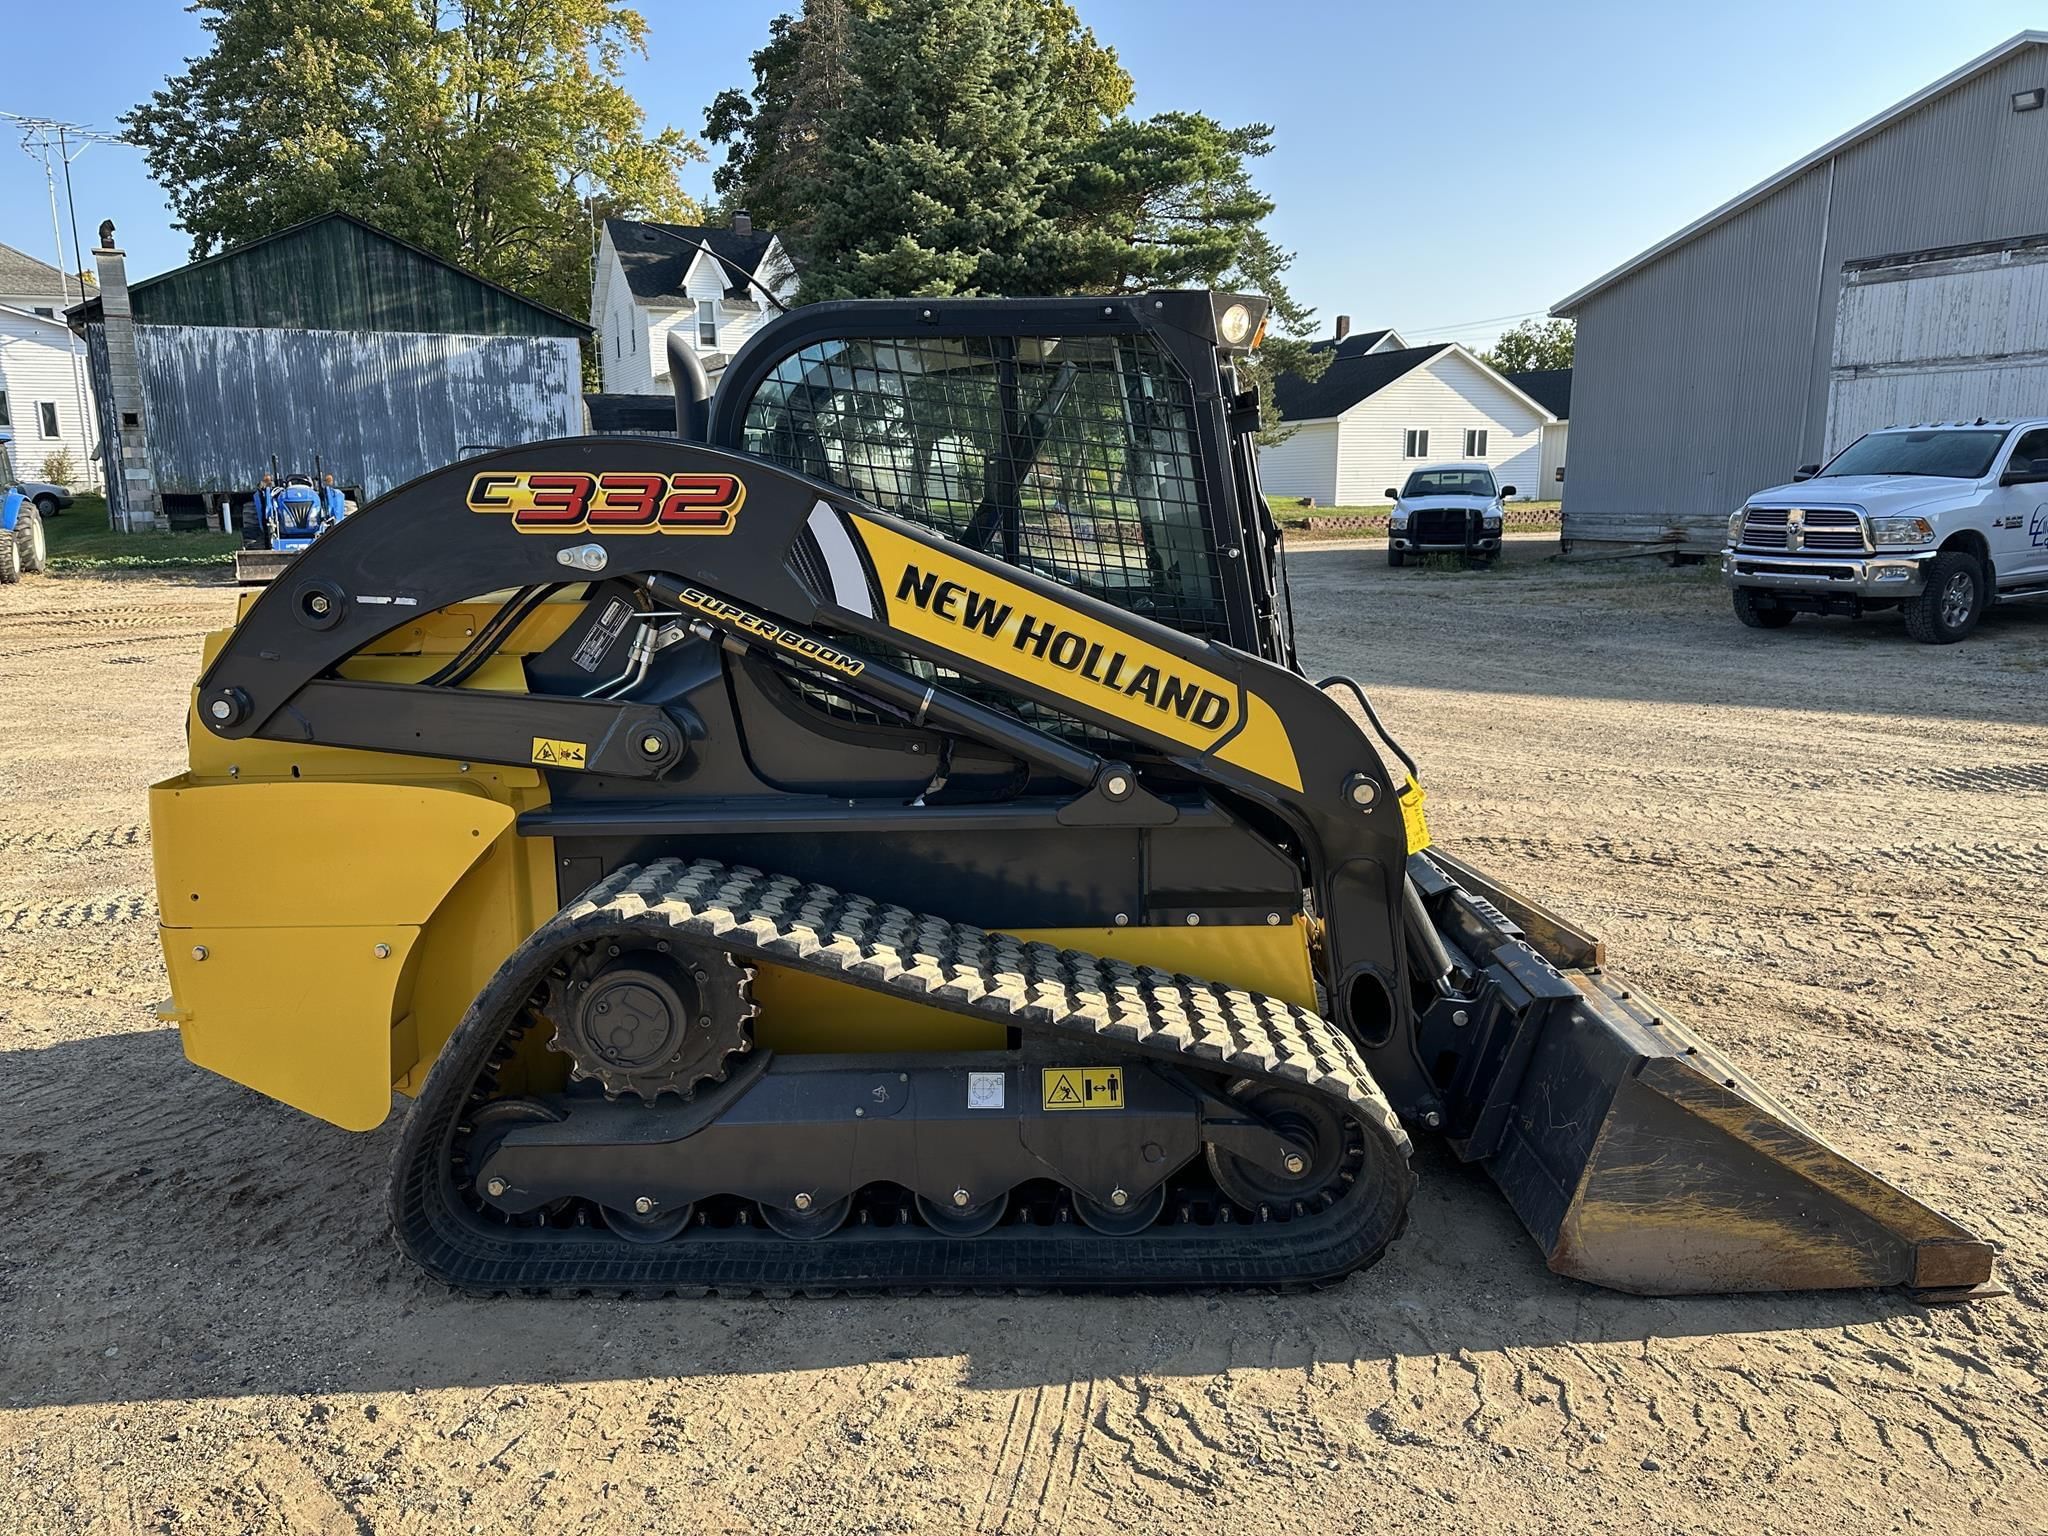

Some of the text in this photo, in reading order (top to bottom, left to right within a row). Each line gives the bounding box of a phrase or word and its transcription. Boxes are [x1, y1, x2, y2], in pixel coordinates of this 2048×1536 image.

[466, 472, 747, 535] C332
[679, 588, 780, 641] SUPER
[776, 630, 866, 677] BOOM
[895, 563, 1231, 731] NEW HOLLAND
